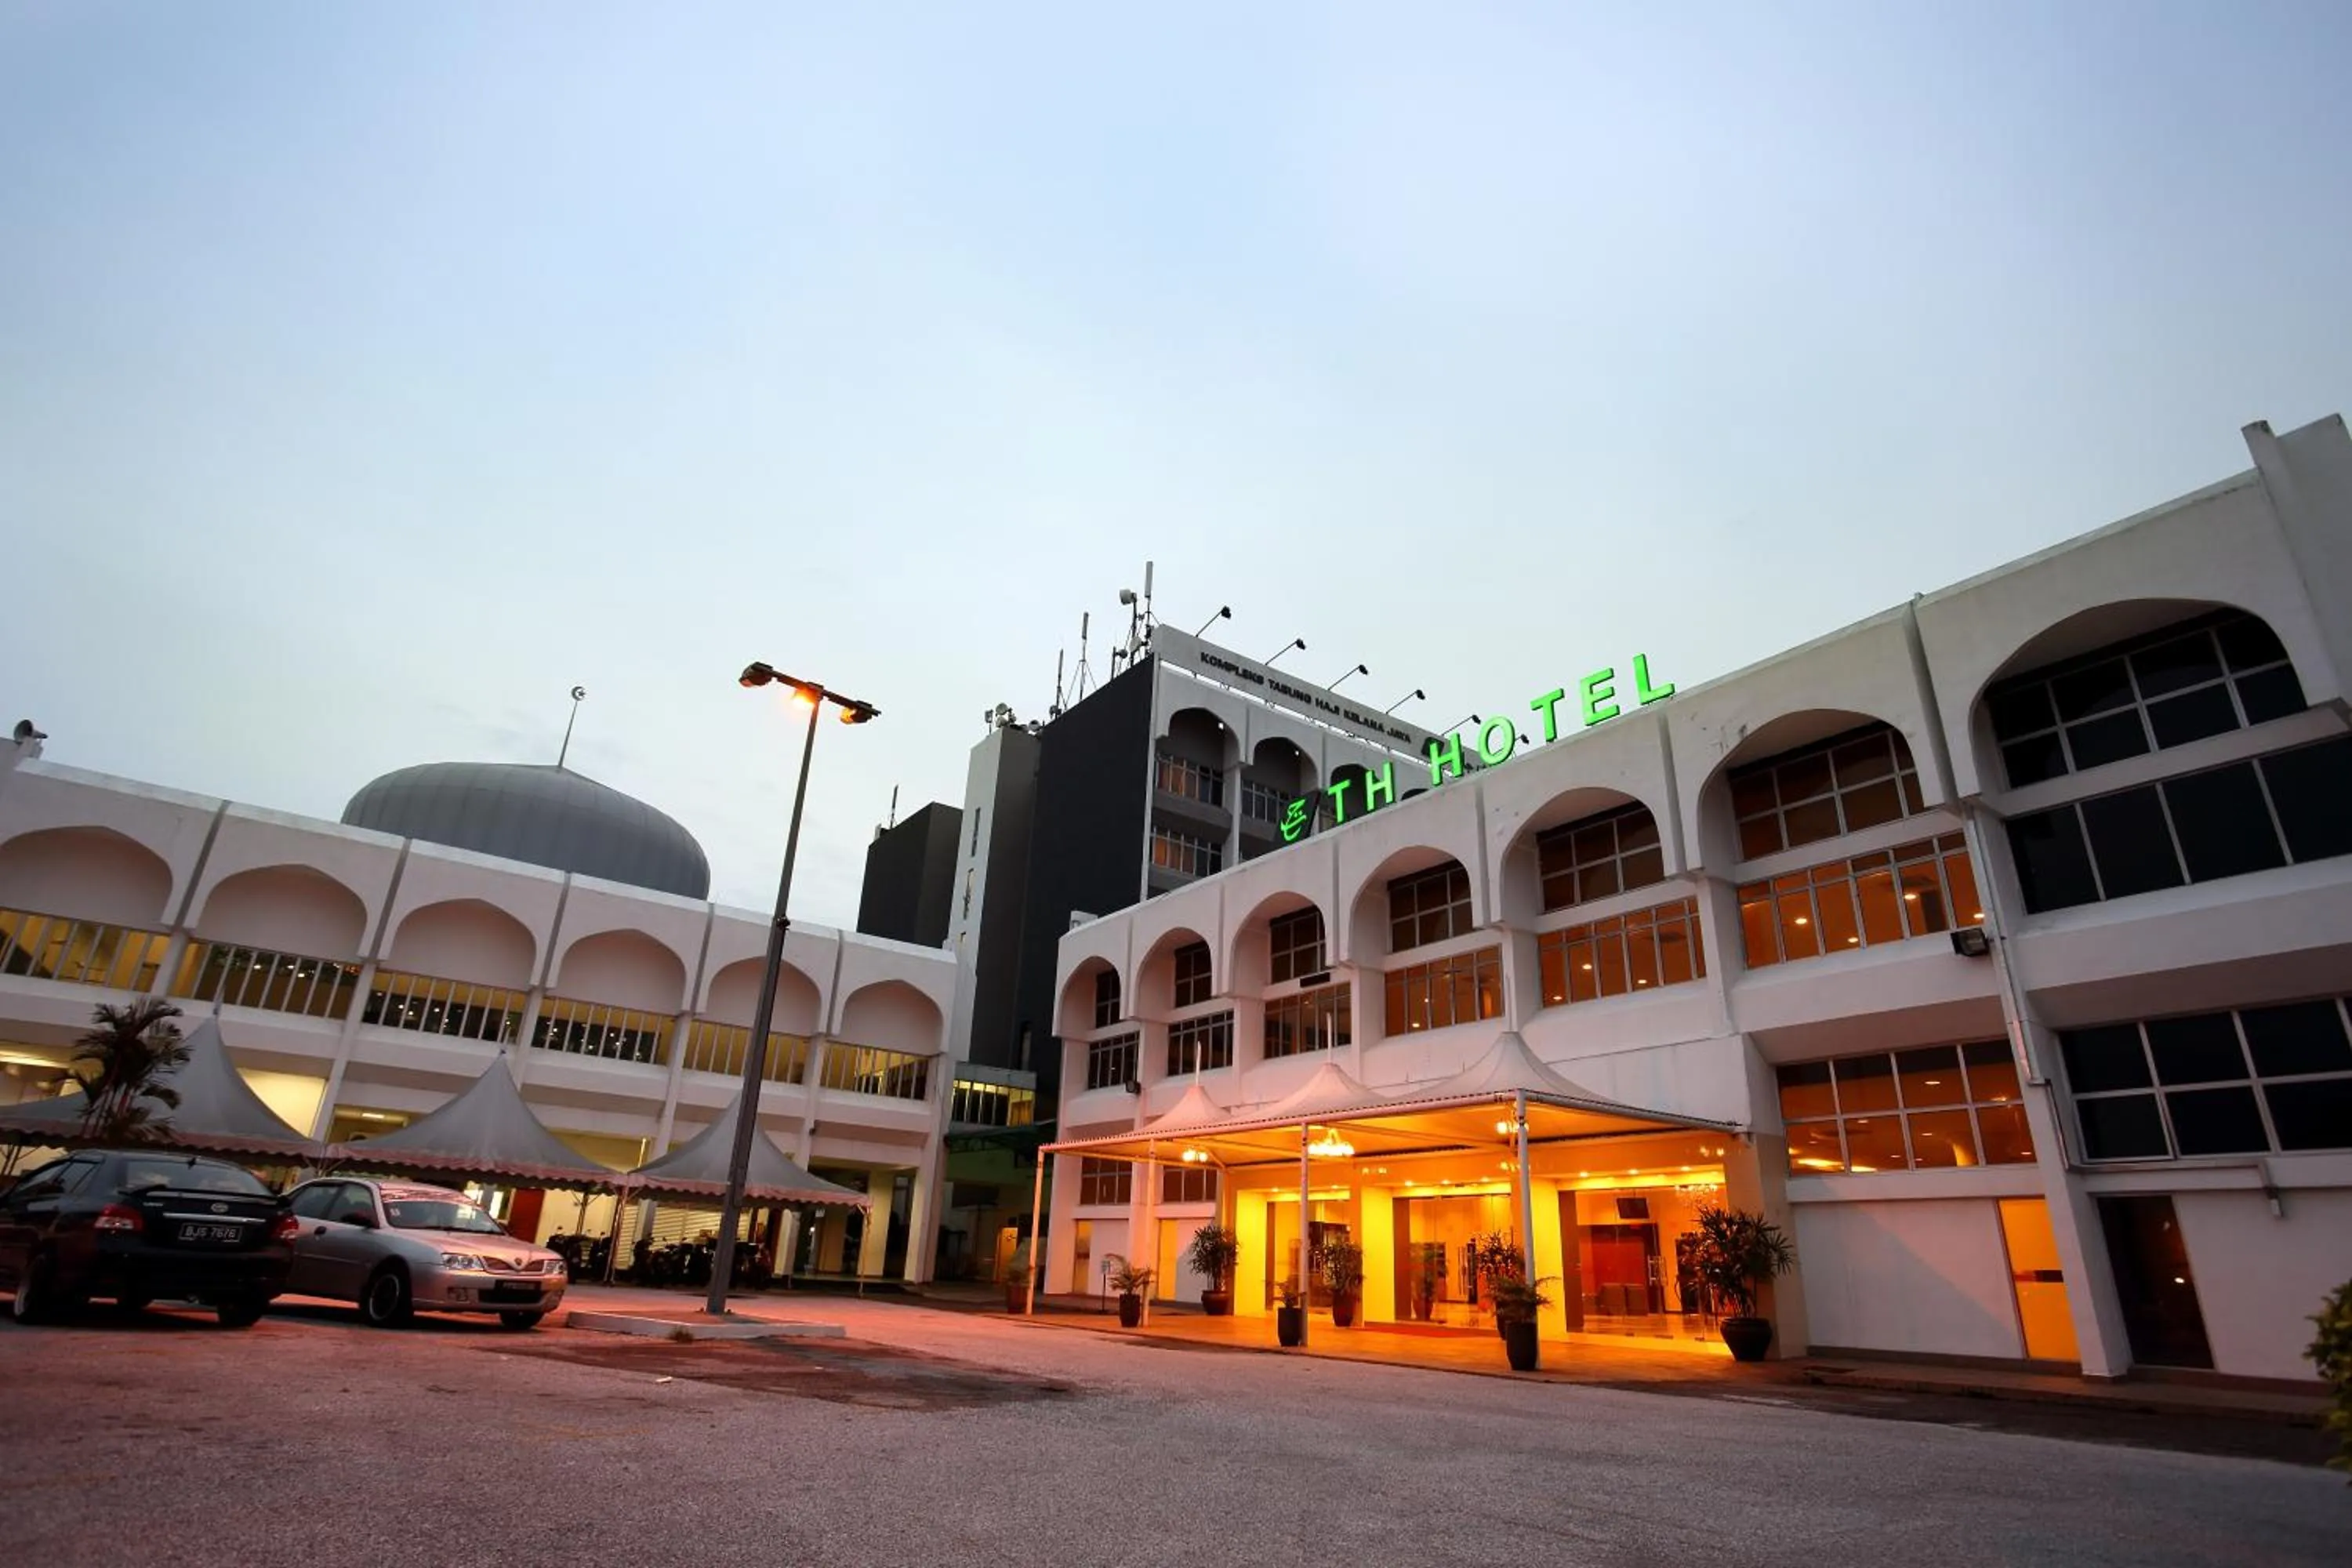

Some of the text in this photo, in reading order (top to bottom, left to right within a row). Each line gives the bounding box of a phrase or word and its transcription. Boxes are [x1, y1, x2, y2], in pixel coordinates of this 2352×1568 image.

[1200, 652, 1412, 744] KOMPLEKS TABUNG HAJI KELANA JAYA
[1328, 760, 1396, 824] TH
[1428, 653, 1675, 786] HOTEL
